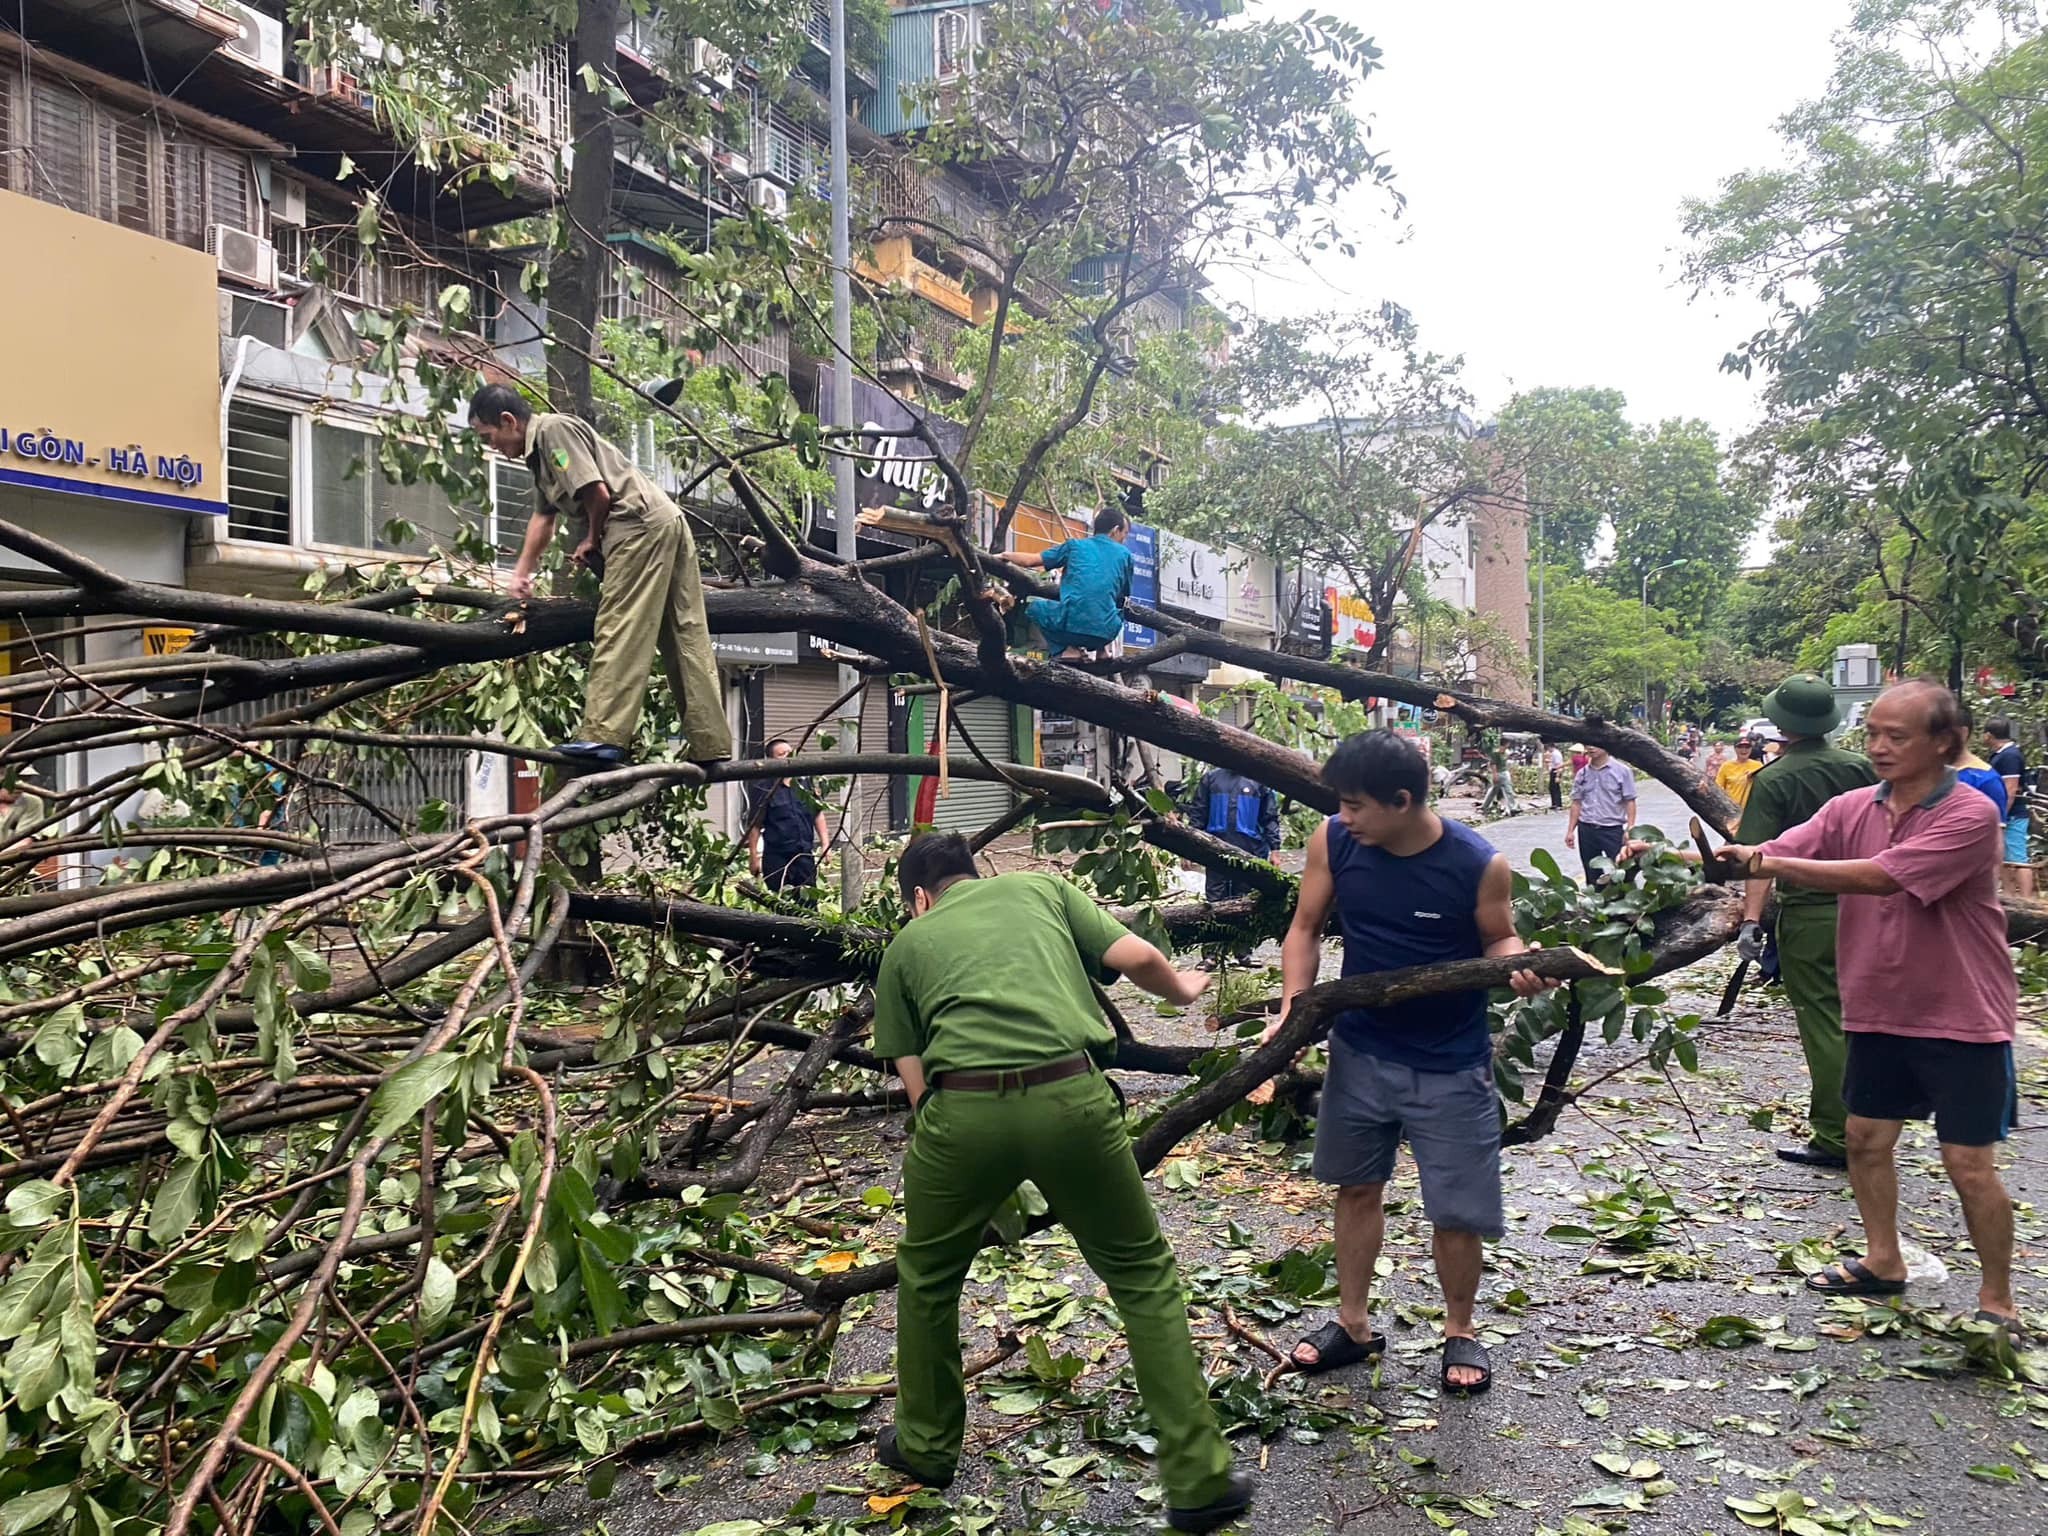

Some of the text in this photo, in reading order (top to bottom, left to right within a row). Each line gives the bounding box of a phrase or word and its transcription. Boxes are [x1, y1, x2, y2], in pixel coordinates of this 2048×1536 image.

[16, 427, 85, 463] GÒN
[110, 444, 149, 477] HÀ
[157, 454, 202, 489] NỘI
